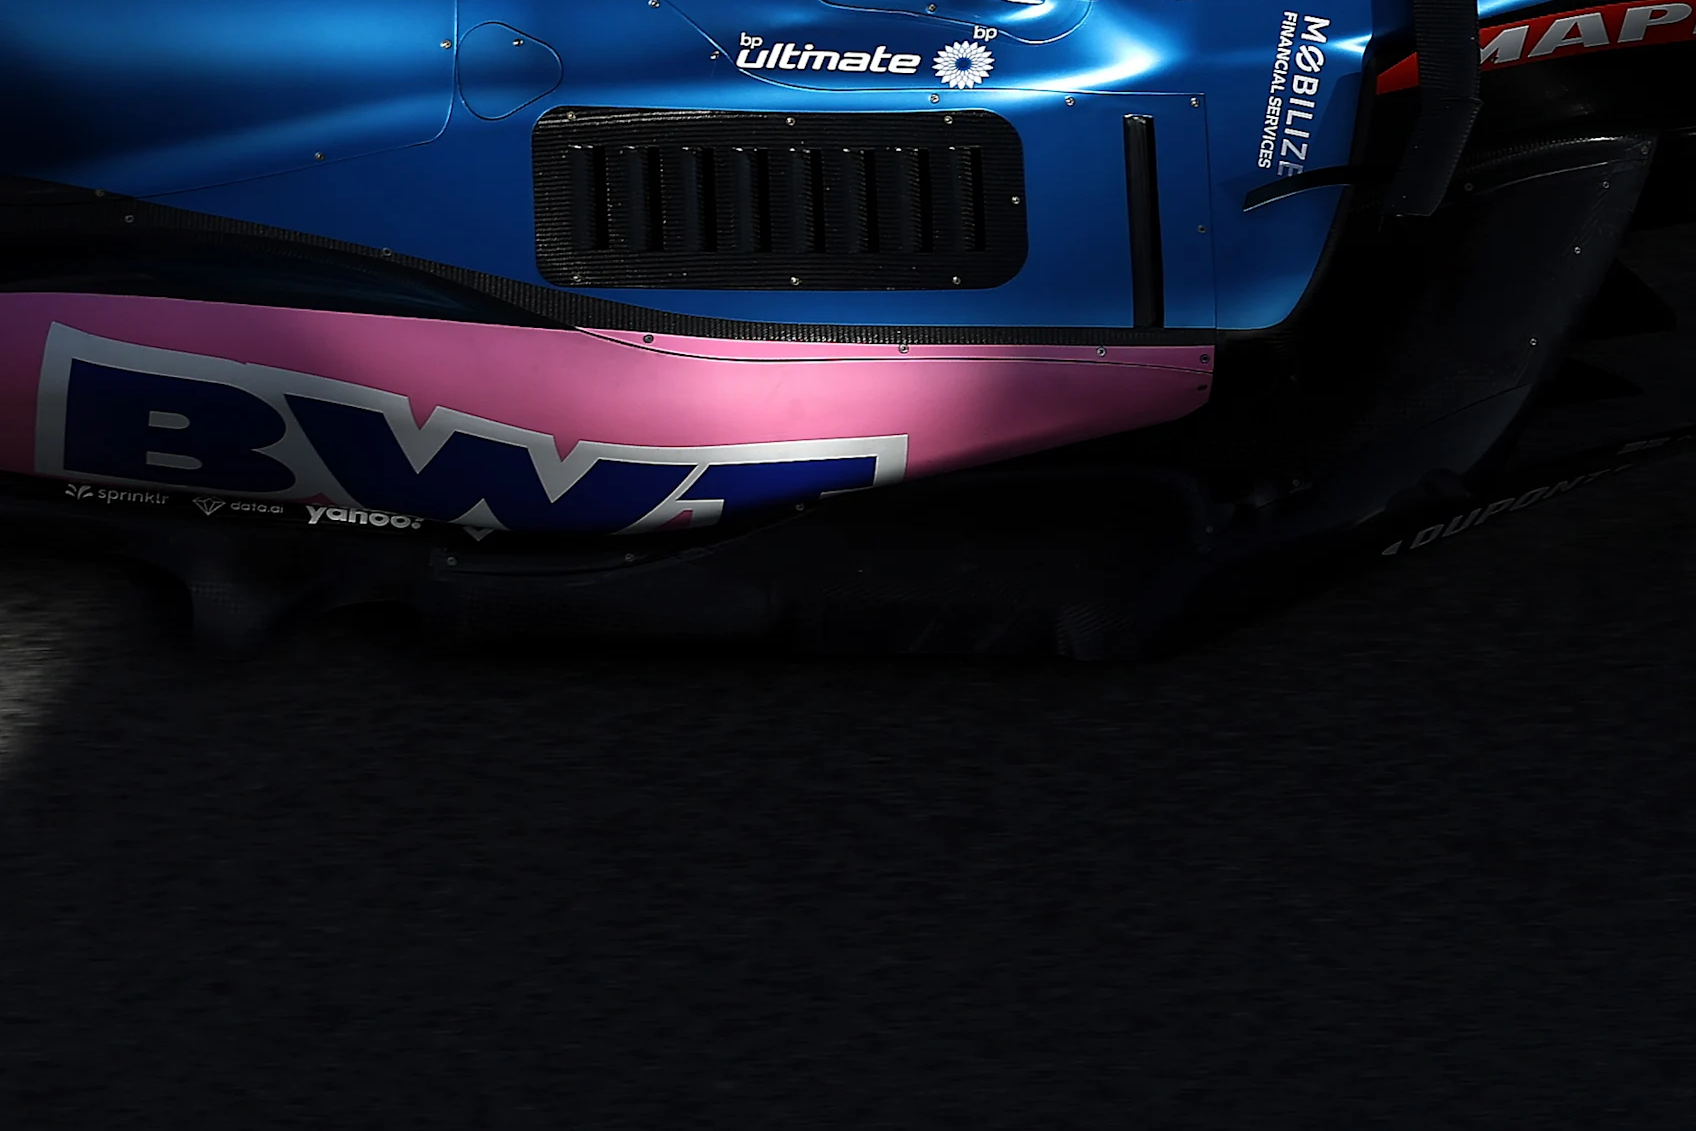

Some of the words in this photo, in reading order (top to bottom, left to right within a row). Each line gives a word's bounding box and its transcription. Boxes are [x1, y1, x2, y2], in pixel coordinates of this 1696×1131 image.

[740, 32, 763, 48] bp
[973, 25, 997, 41] bp
[736, 40, 921, 73] ultimate
[1270, 11, 1298, 93] FINANCIAL
[1258, 96, 1282, 168] SERVICES
[58, 350, 884, 535] BWT
[98, 488, 169, 505] sprinklr
[230, 501, 284, 514] data.ai
